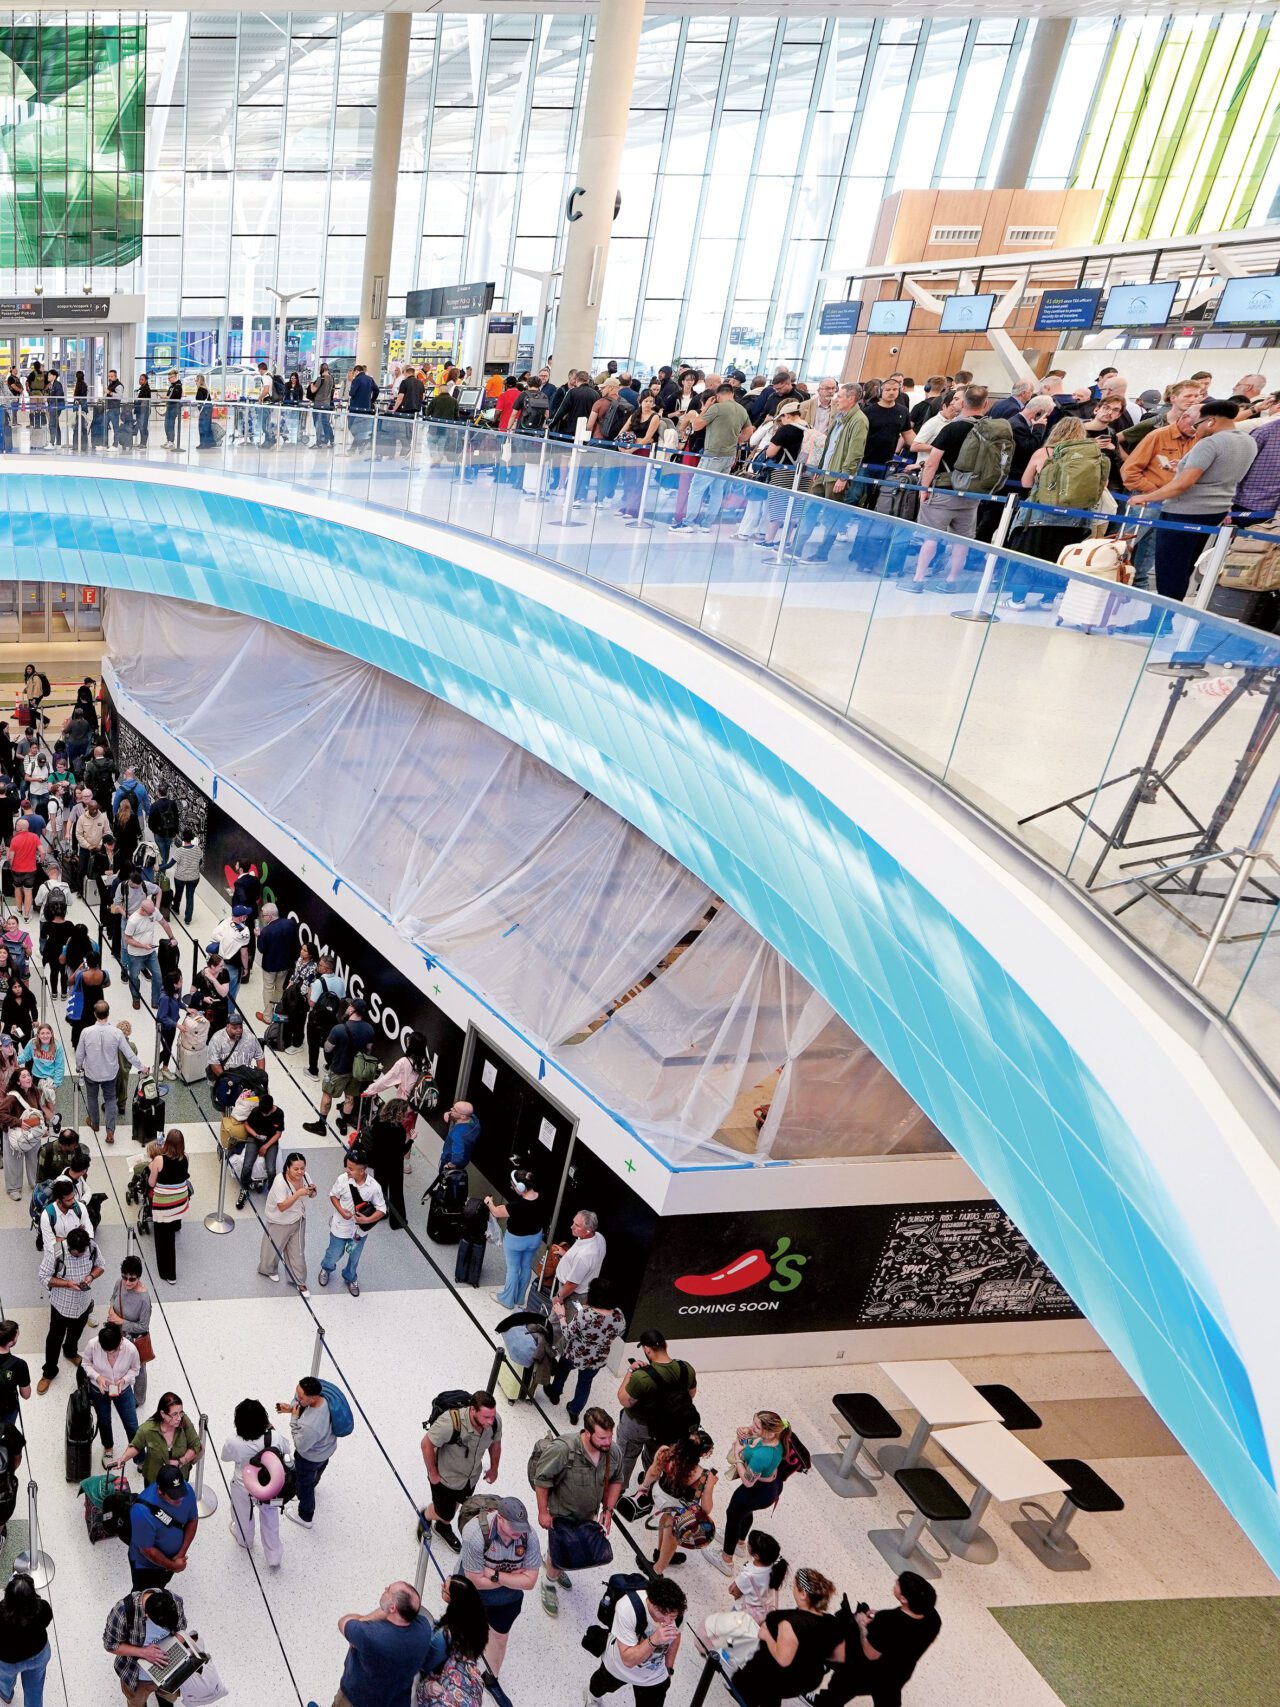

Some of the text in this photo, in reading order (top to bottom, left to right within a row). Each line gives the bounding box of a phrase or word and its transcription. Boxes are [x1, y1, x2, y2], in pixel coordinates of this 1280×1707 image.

[567, 187, 586, 222] C
[87, 591, 92, 602] E
[907, 1214, 935, 1223] BURGERS
[873, 1239, 900, 1295] FAMILY
[901, 1263, 929, 1275] SPICY
[678, 1301, 780, 1315] COMING SOON
